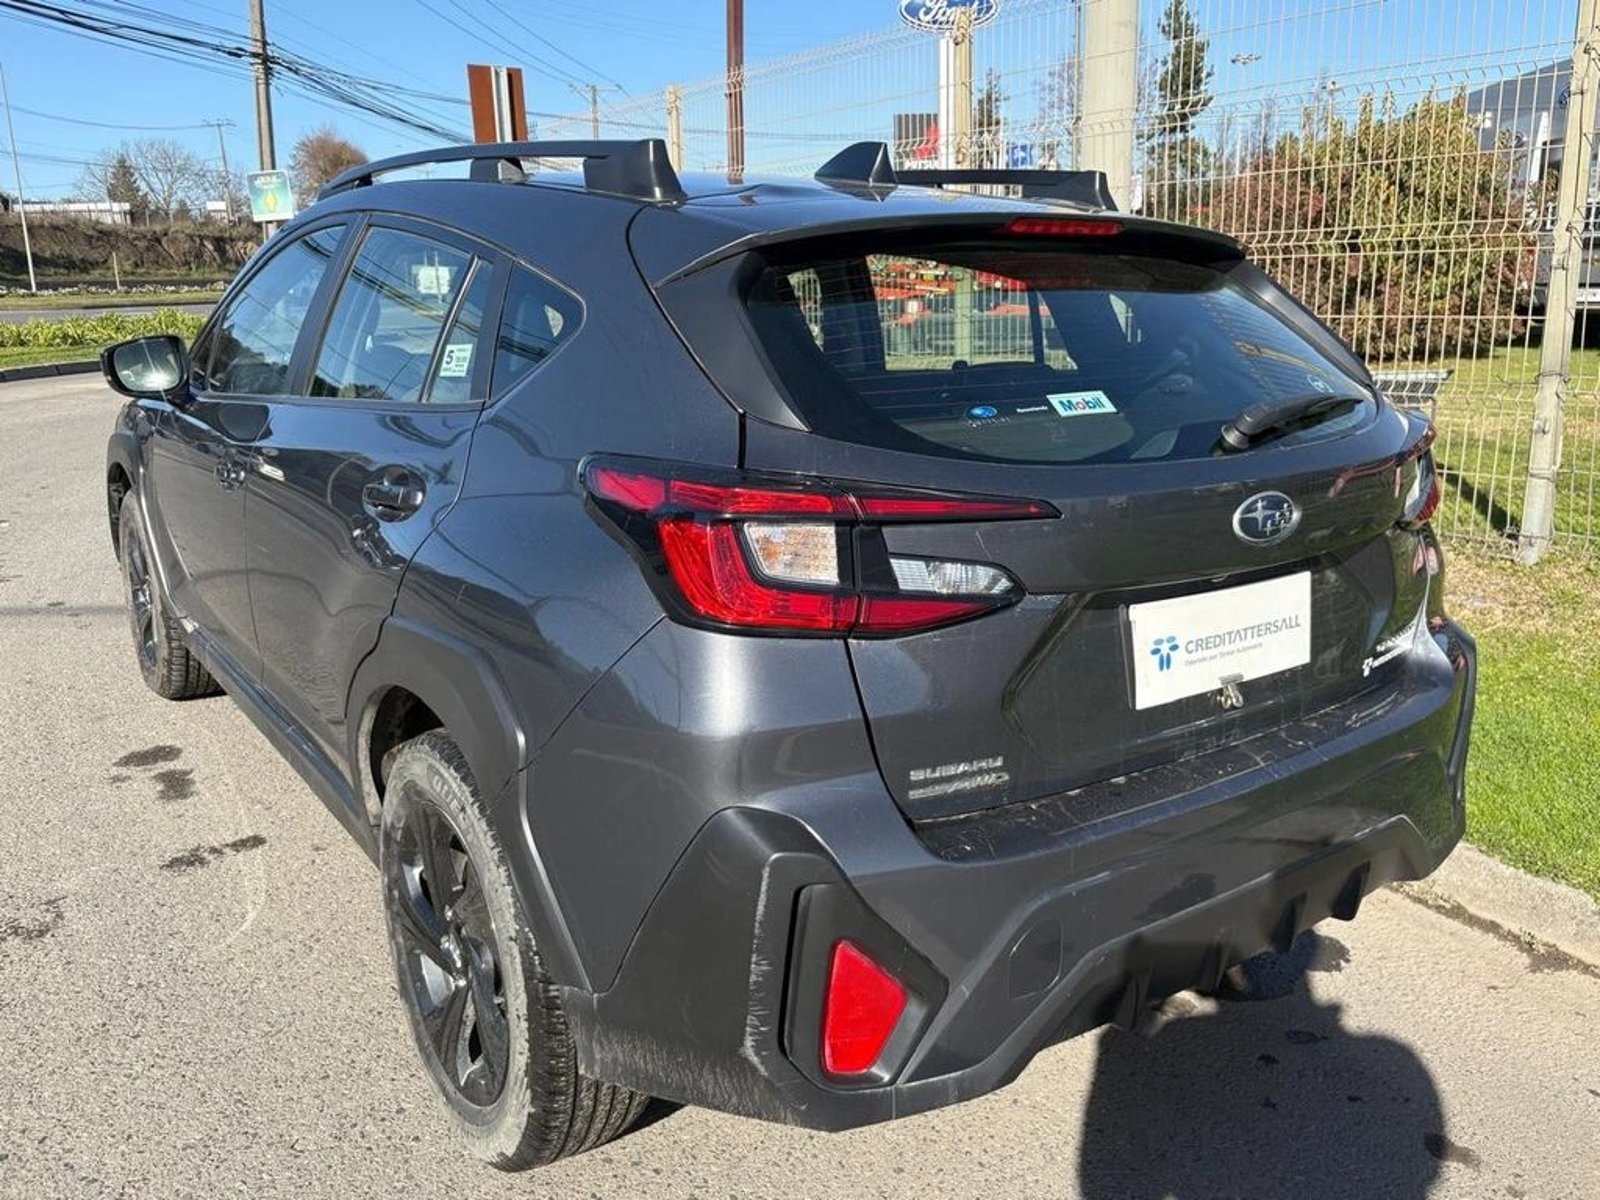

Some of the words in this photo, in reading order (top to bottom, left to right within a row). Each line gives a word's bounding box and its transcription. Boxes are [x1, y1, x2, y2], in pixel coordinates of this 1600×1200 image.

[445, 350, 454, 365] 5
[1058, 397, 1105, 412] Mobil
[1185, 614, 1301, 654] CREDITATTERSALL
[909, 756, 1003, 780] SUBARU
